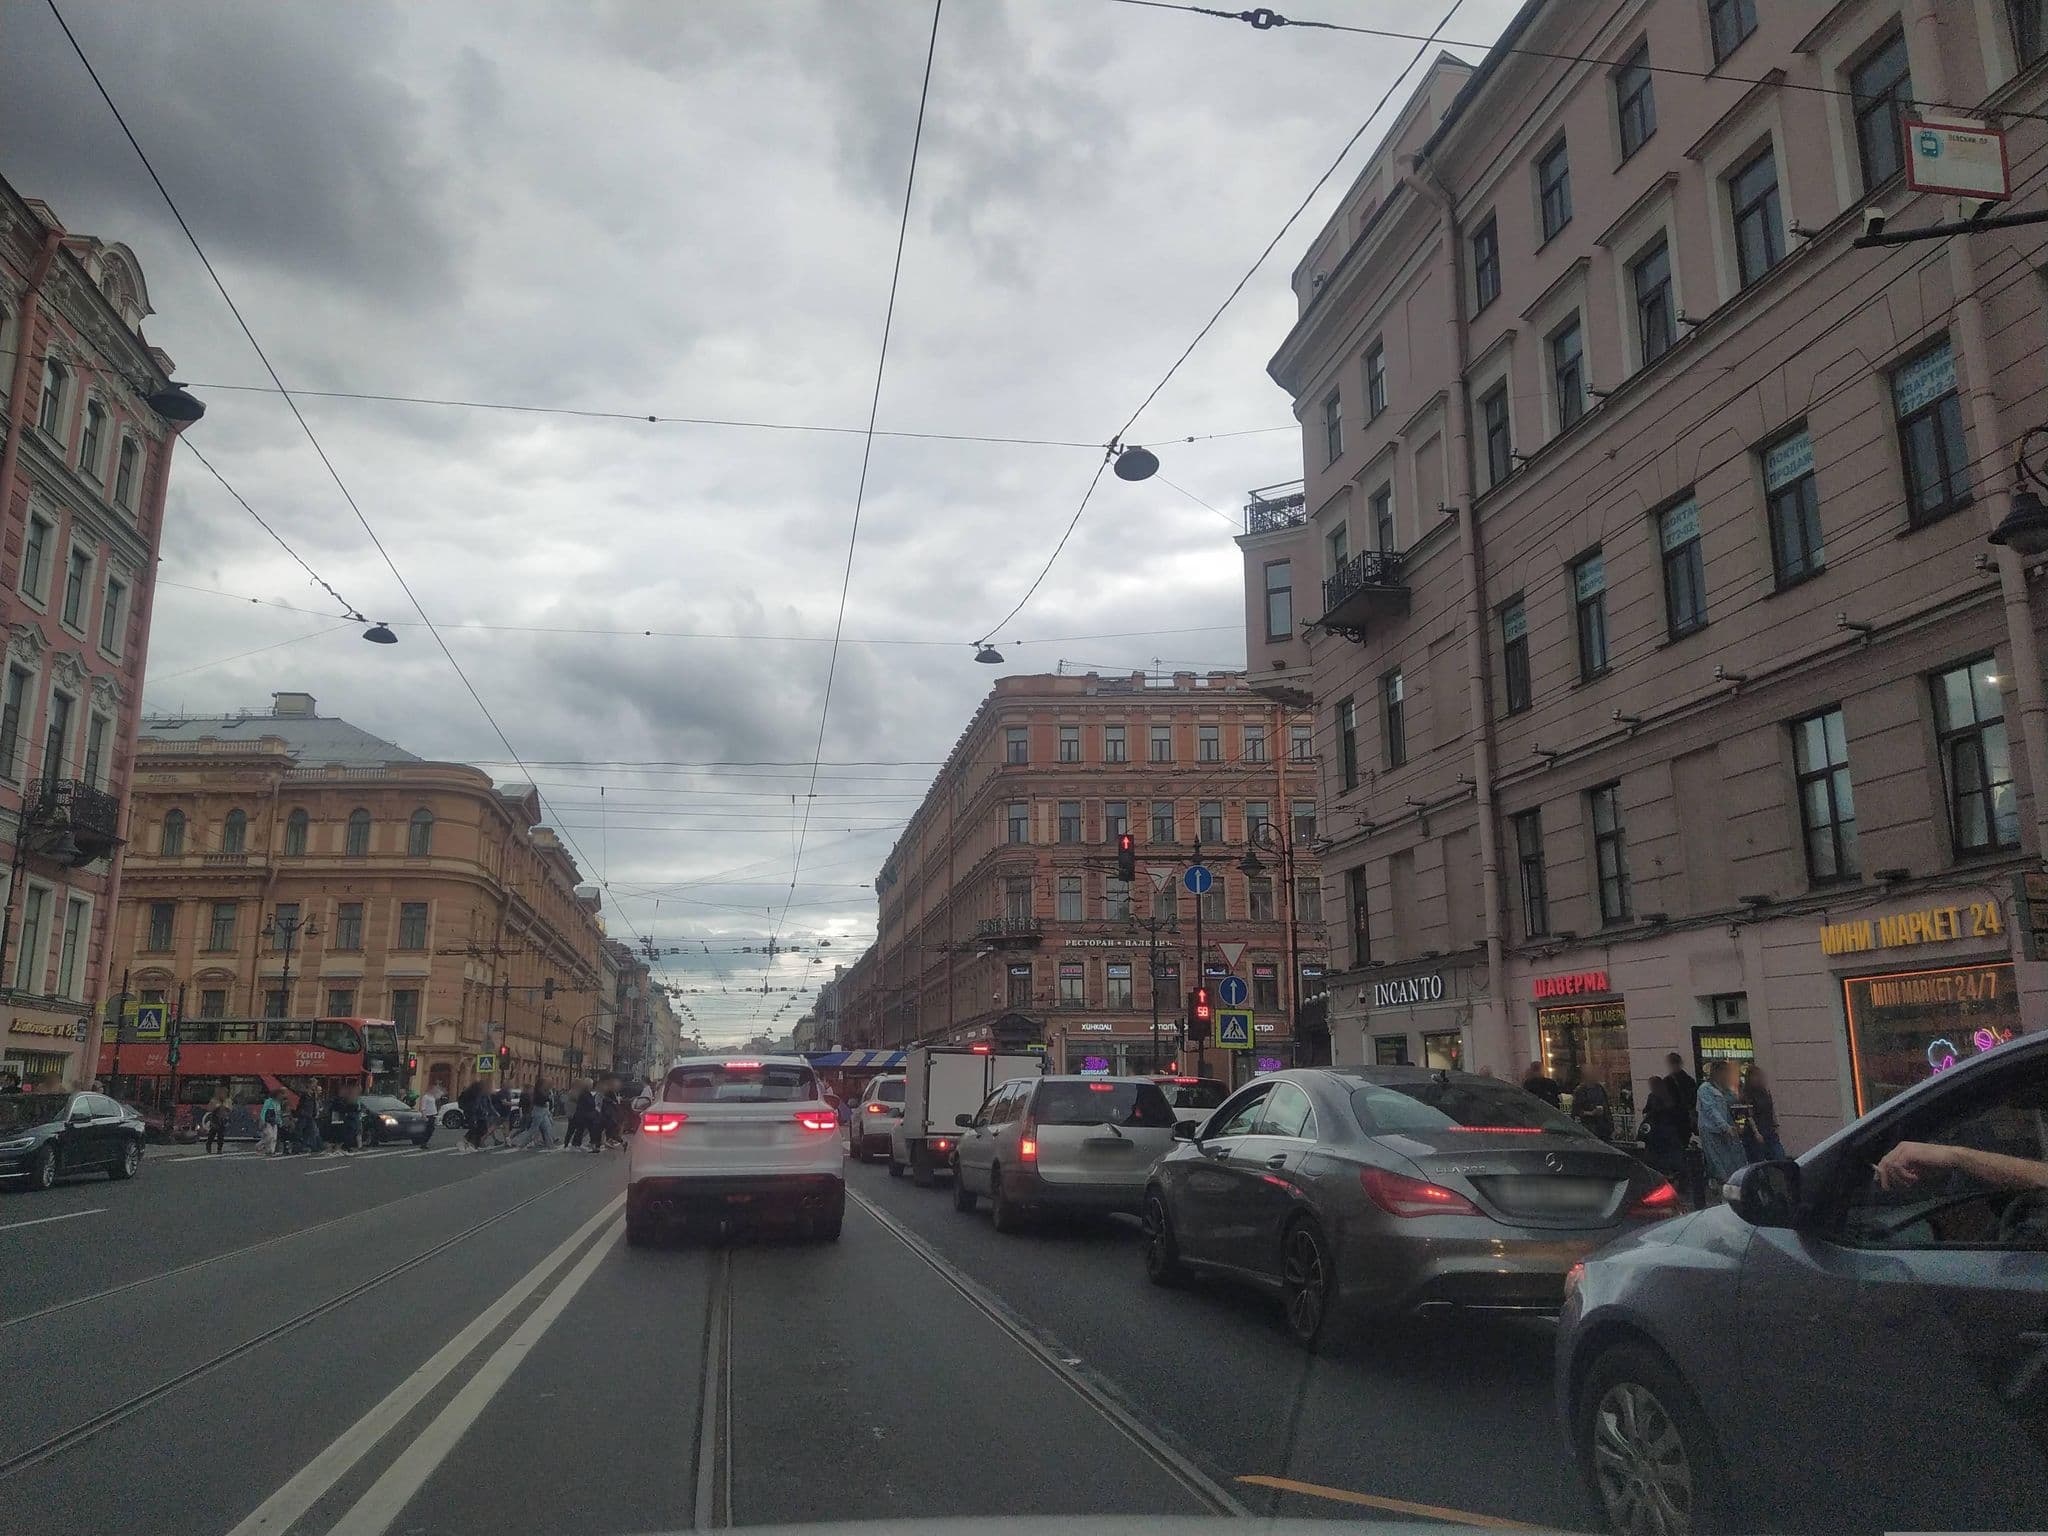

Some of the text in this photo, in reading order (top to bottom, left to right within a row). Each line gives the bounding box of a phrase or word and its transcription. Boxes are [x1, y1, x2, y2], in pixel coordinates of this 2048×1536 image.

[1820, 919, 1872, 955] МИНИ
[1879, 905, 1960, 948] МАРКЕТ
[1969, 900, 2001, 937] 24
[1065, 939, 1114, 947] РЕСТОРАН
[1374, 975, 1443, 1006] INCANTO
[1533, 971, 1607, 999] ШАВЕРМА
[1871, 972, 1998, 1007] MINI MARKET 24/7
[1700, 1037, 1753, 1050] ШАВЕРМА
